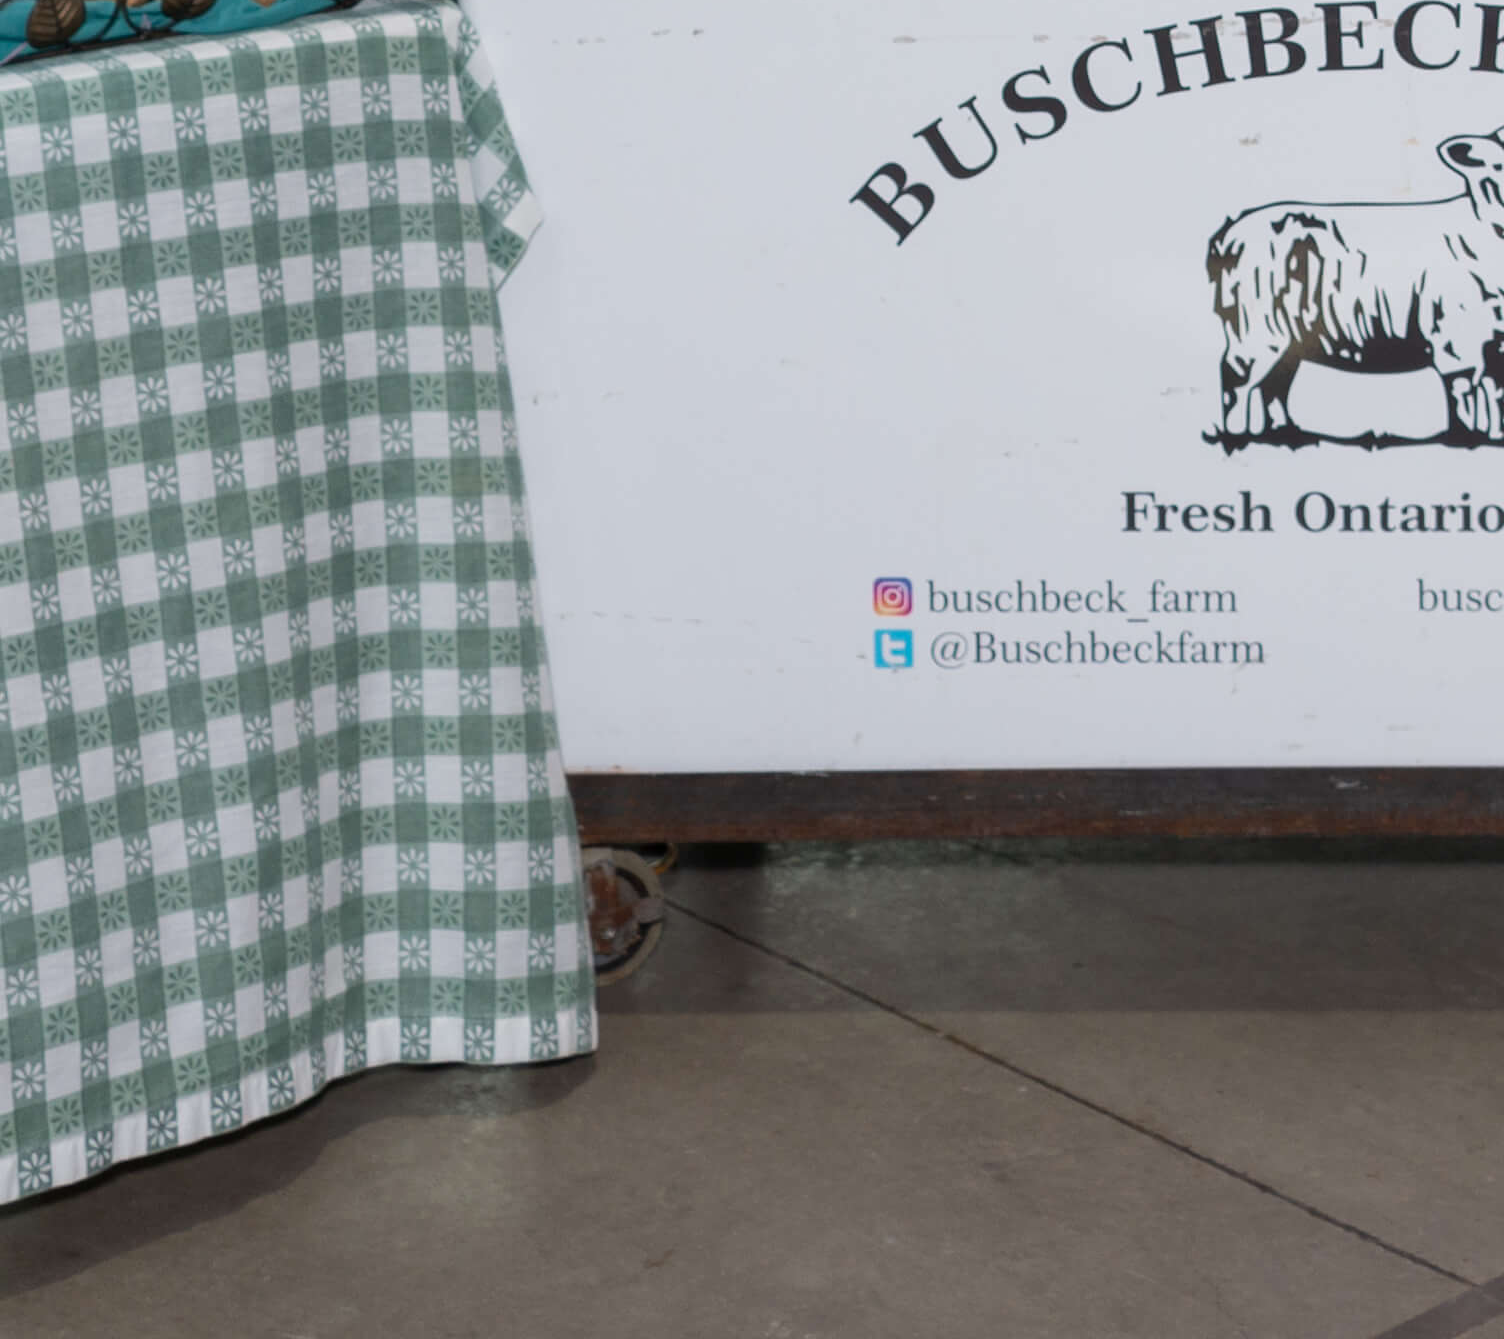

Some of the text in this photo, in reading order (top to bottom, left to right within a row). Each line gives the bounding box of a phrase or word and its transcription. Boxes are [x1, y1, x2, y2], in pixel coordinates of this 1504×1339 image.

[1121, 491, 1274, 534] Fresh
[927, 578, 1239, 625] buschbeck_farm
[928, 628, 1266, 667] @Buschbeckfarm
